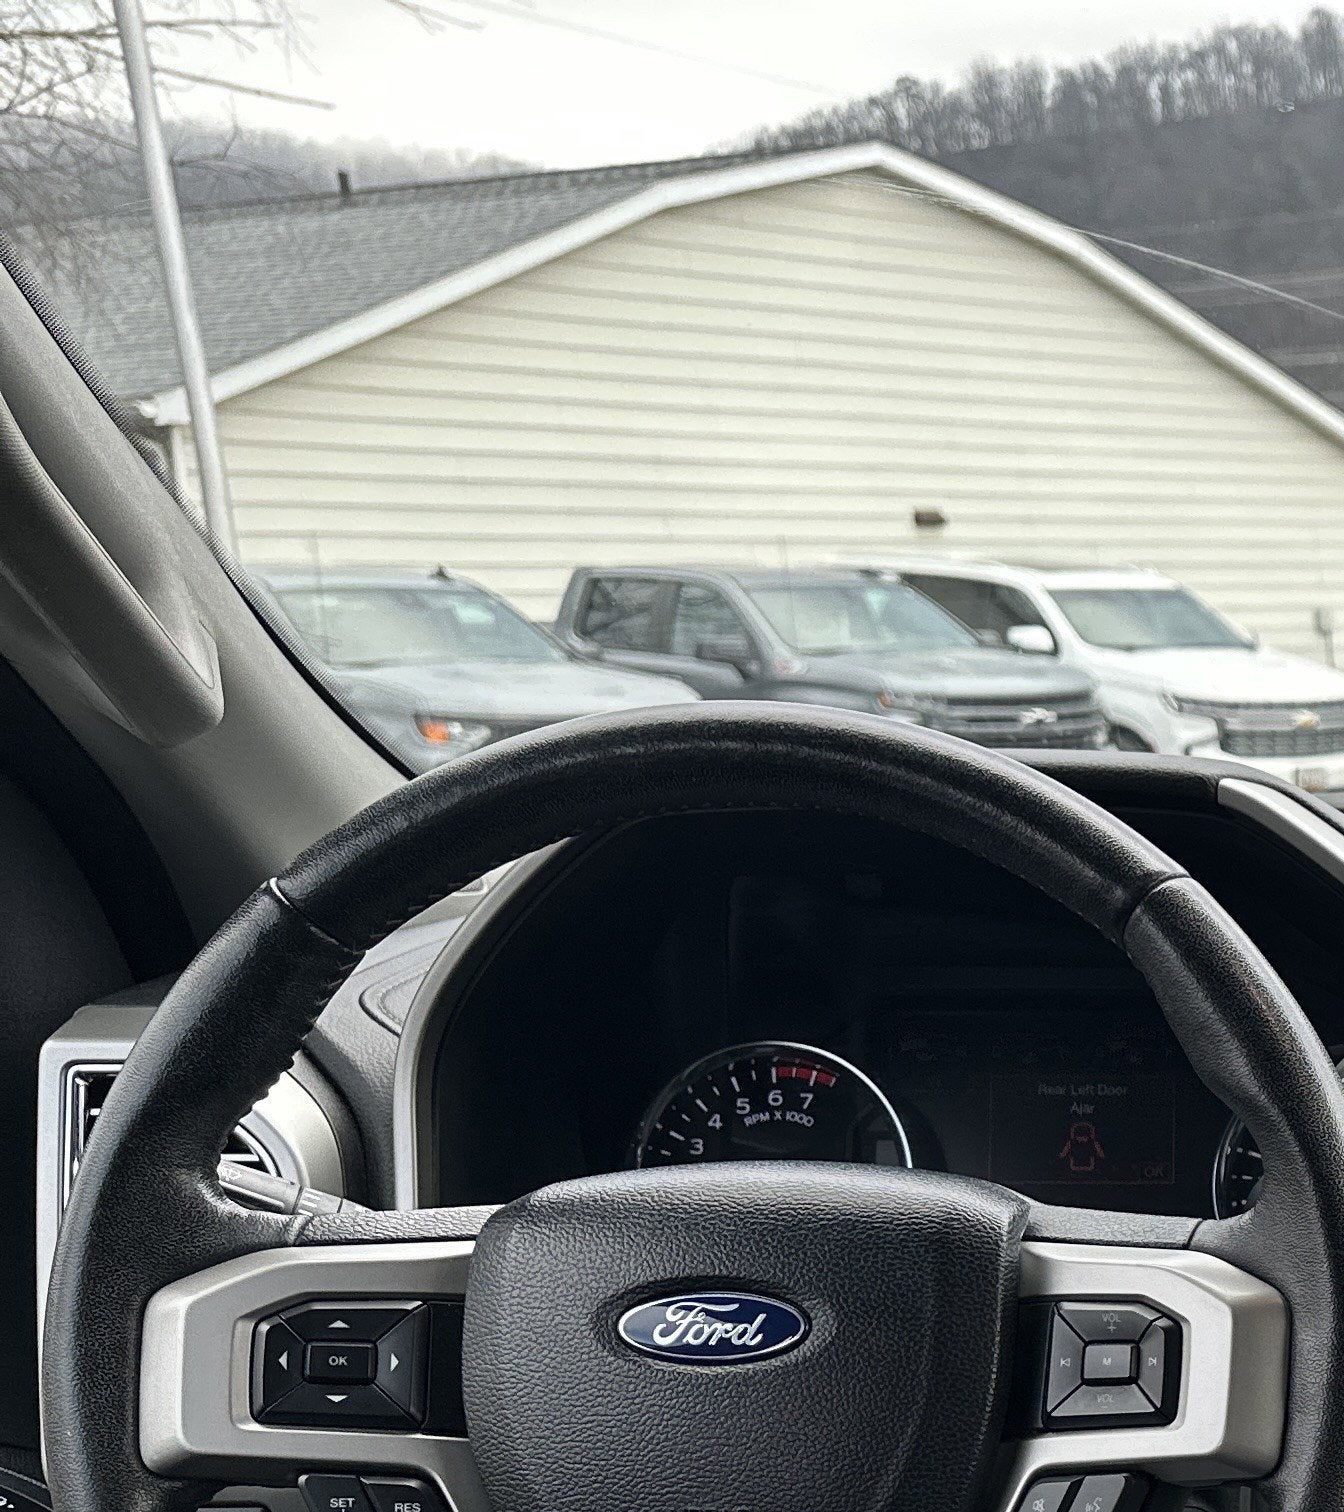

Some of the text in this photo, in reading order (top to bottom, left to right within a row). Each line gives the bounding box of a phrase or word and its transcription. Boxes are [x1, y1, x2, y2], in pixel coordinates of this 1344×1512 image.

[735, 1098, 750, 1115] 5
[767, 1089, 783, 1107] 6
[799, 1092, 814, 1110] 7
[707, 1113, 723, 1130] 4
[743, 1112, 770, 1127] RPM
[785, 1111, 815, 1128] 1000
[689, 1138, 704, 1155] 3
[652, 1300, 767, 1347] Ford
[328, 1355, 348, 1366] OK
[329, 1497, 355, 1509] SET
